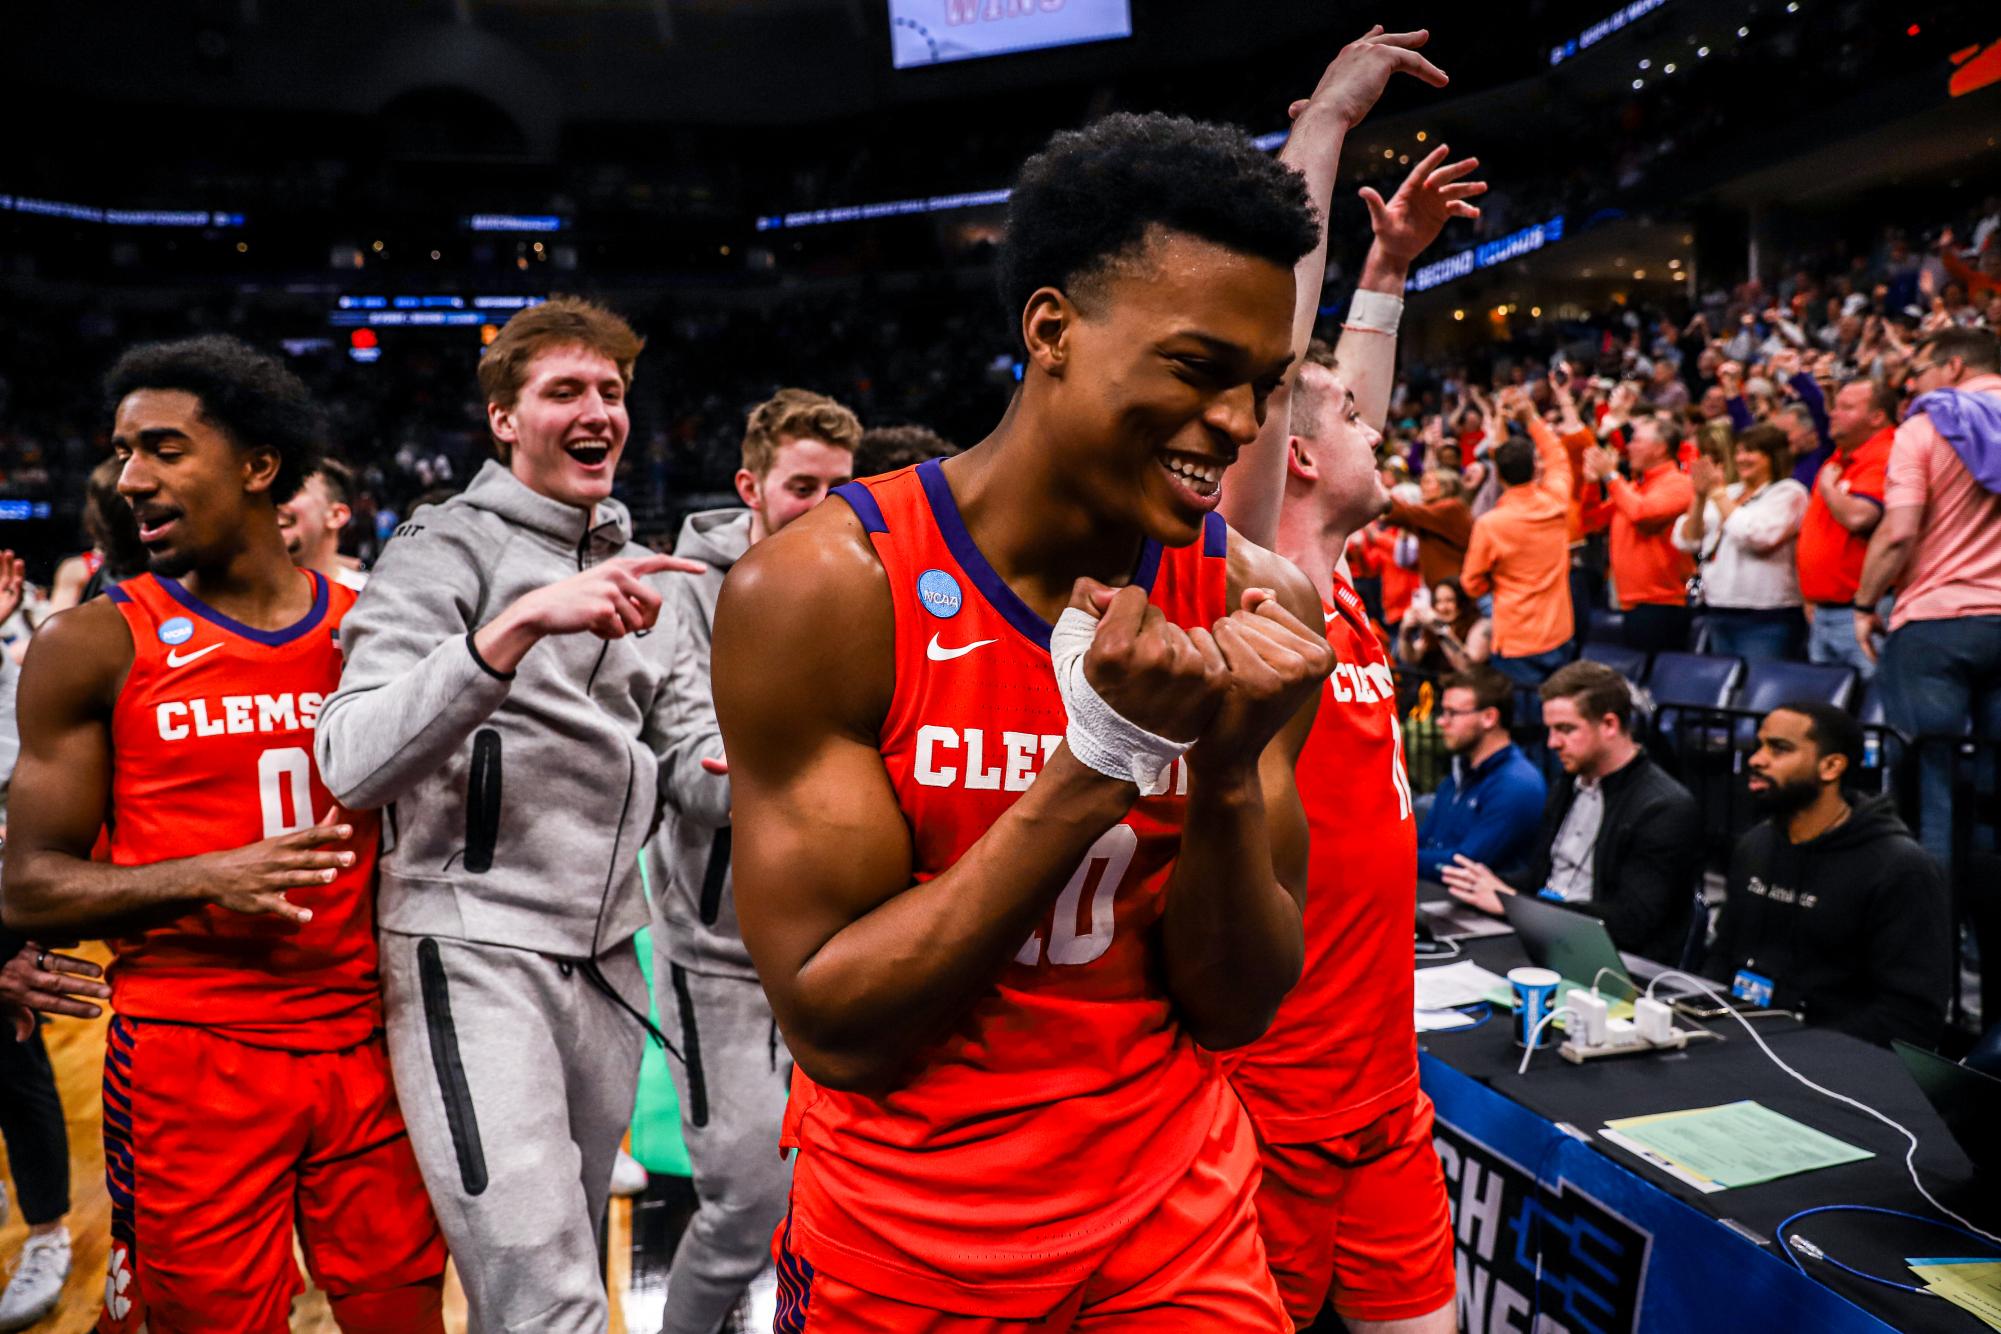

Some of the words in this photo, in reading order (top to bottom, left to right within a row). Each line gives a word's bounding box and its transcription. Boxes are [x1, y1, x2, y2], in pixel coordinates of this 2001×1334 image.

[923, 588, 959, 608] NCAA
[156, 692, 334, 742] CLEMS
[258, 747, 315, 841] 0
[1013, 823, 1138, 966] 0
[1455, 1247, 1571, 1334] NE
